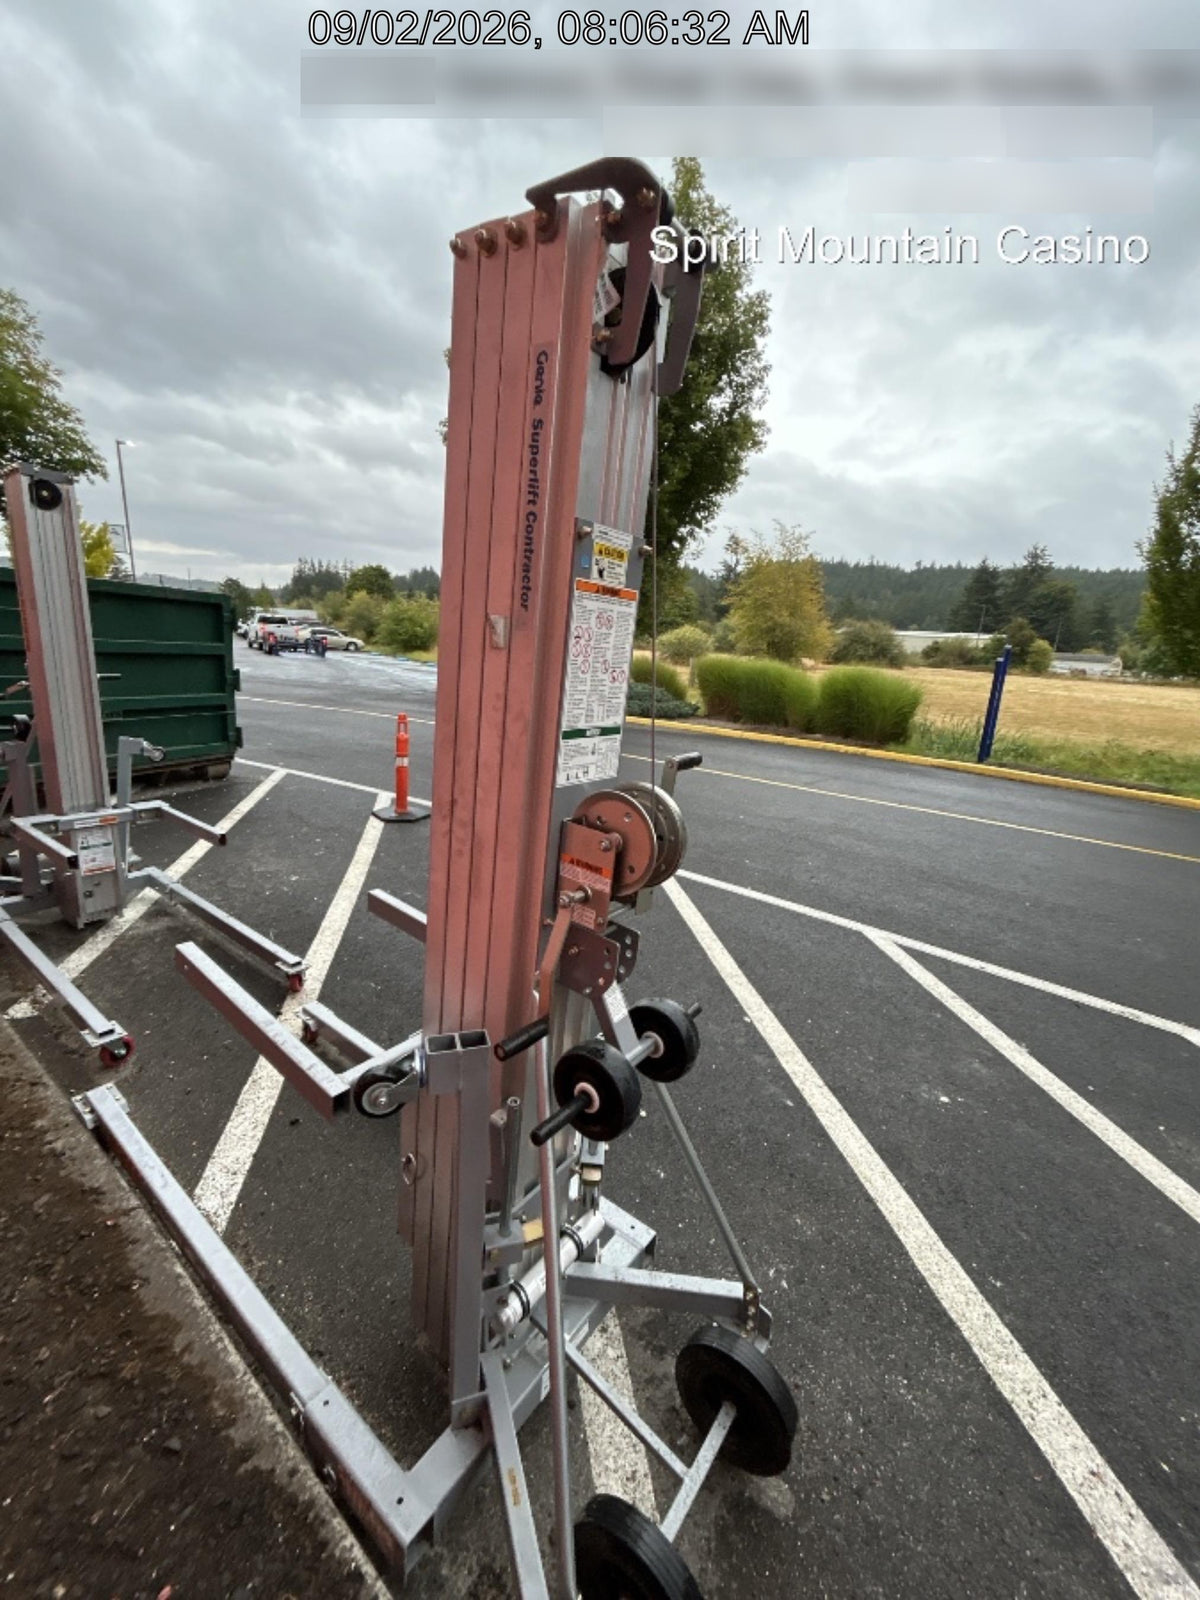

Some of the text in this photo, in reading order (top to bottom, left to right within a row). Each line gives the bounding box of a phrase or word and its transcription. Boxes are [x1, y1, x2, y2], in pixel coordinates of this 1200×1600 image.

[520, 349, 549, 612] Genie Superlift Contractor
